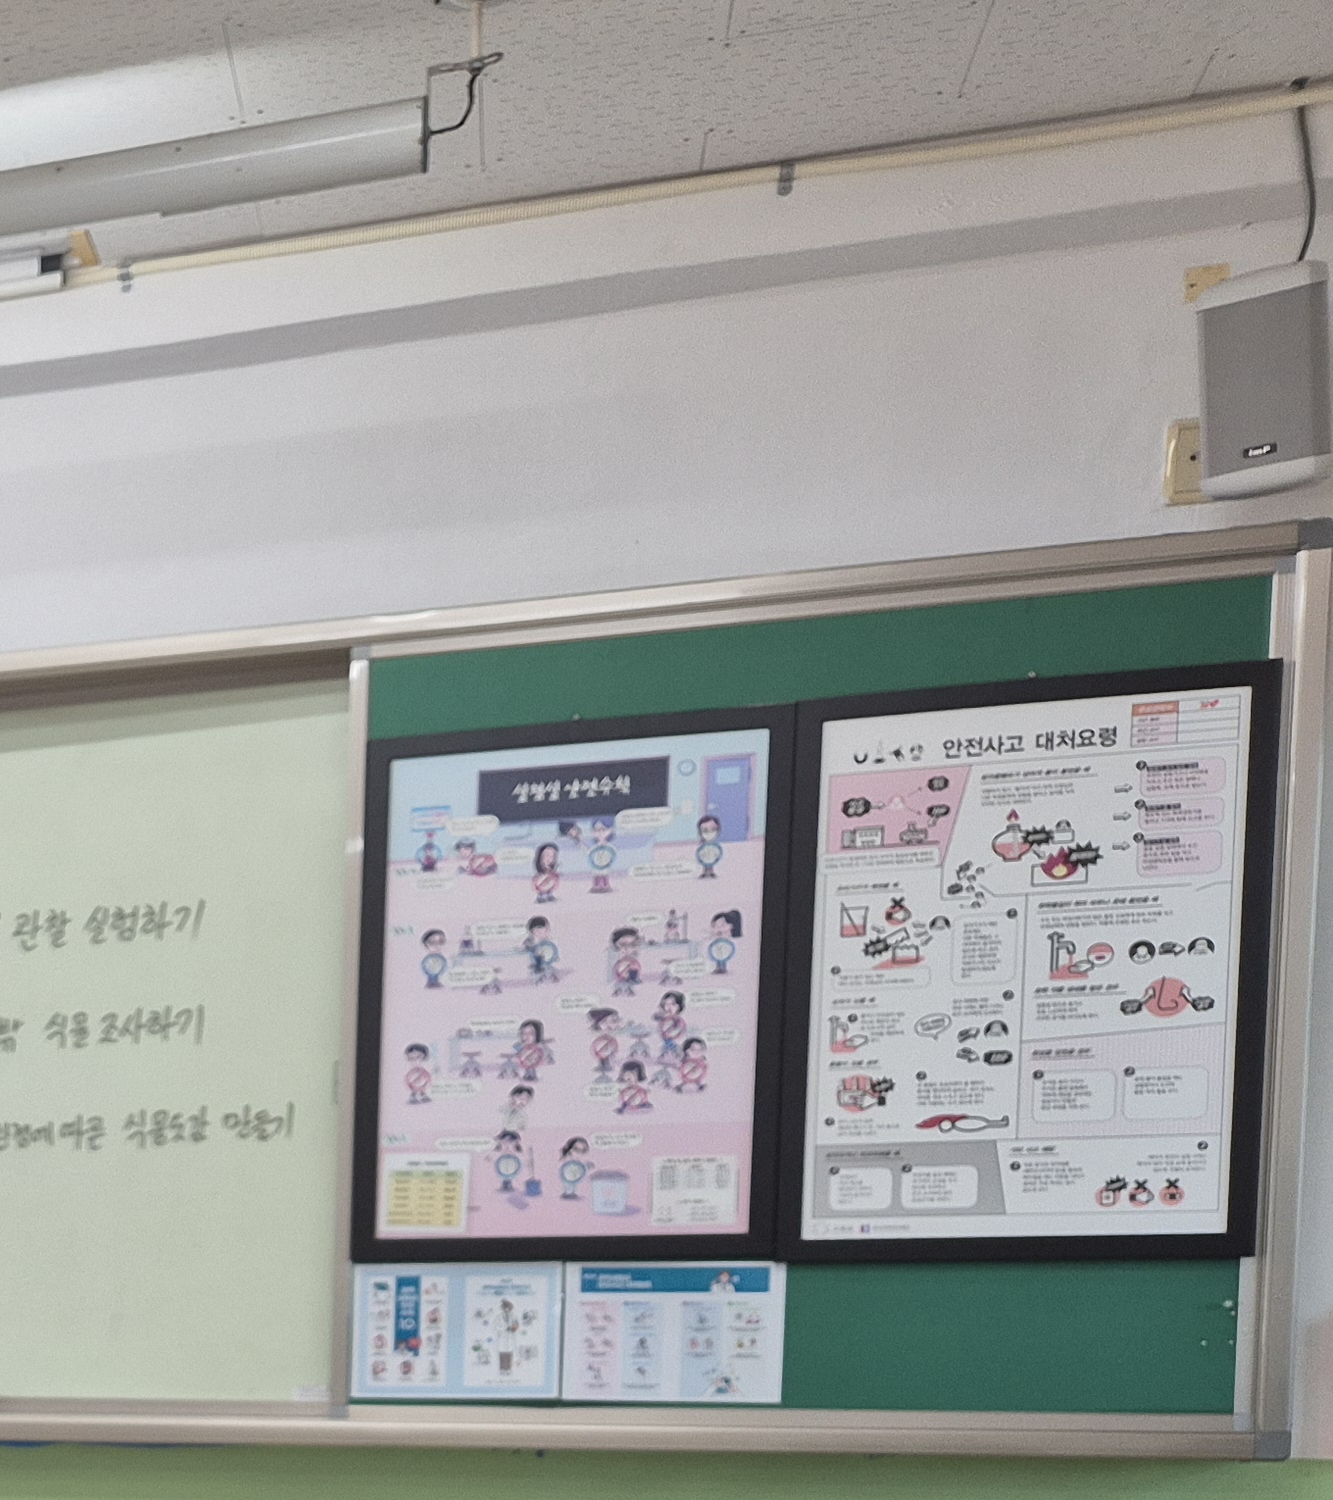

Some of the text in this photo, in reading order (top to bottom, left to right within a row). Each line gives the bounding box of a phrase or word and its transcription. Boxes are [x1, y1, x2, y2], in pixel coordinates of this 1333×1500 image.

[942, 733, 1025, 760] 안전사고
[1035, 725, 1118, 753] 대처요령
[83, 897, 207, 945] 실험하기
[43, 1010, 91, 1050] 식물
[95, 1002, 206, 1048] 조사하기
